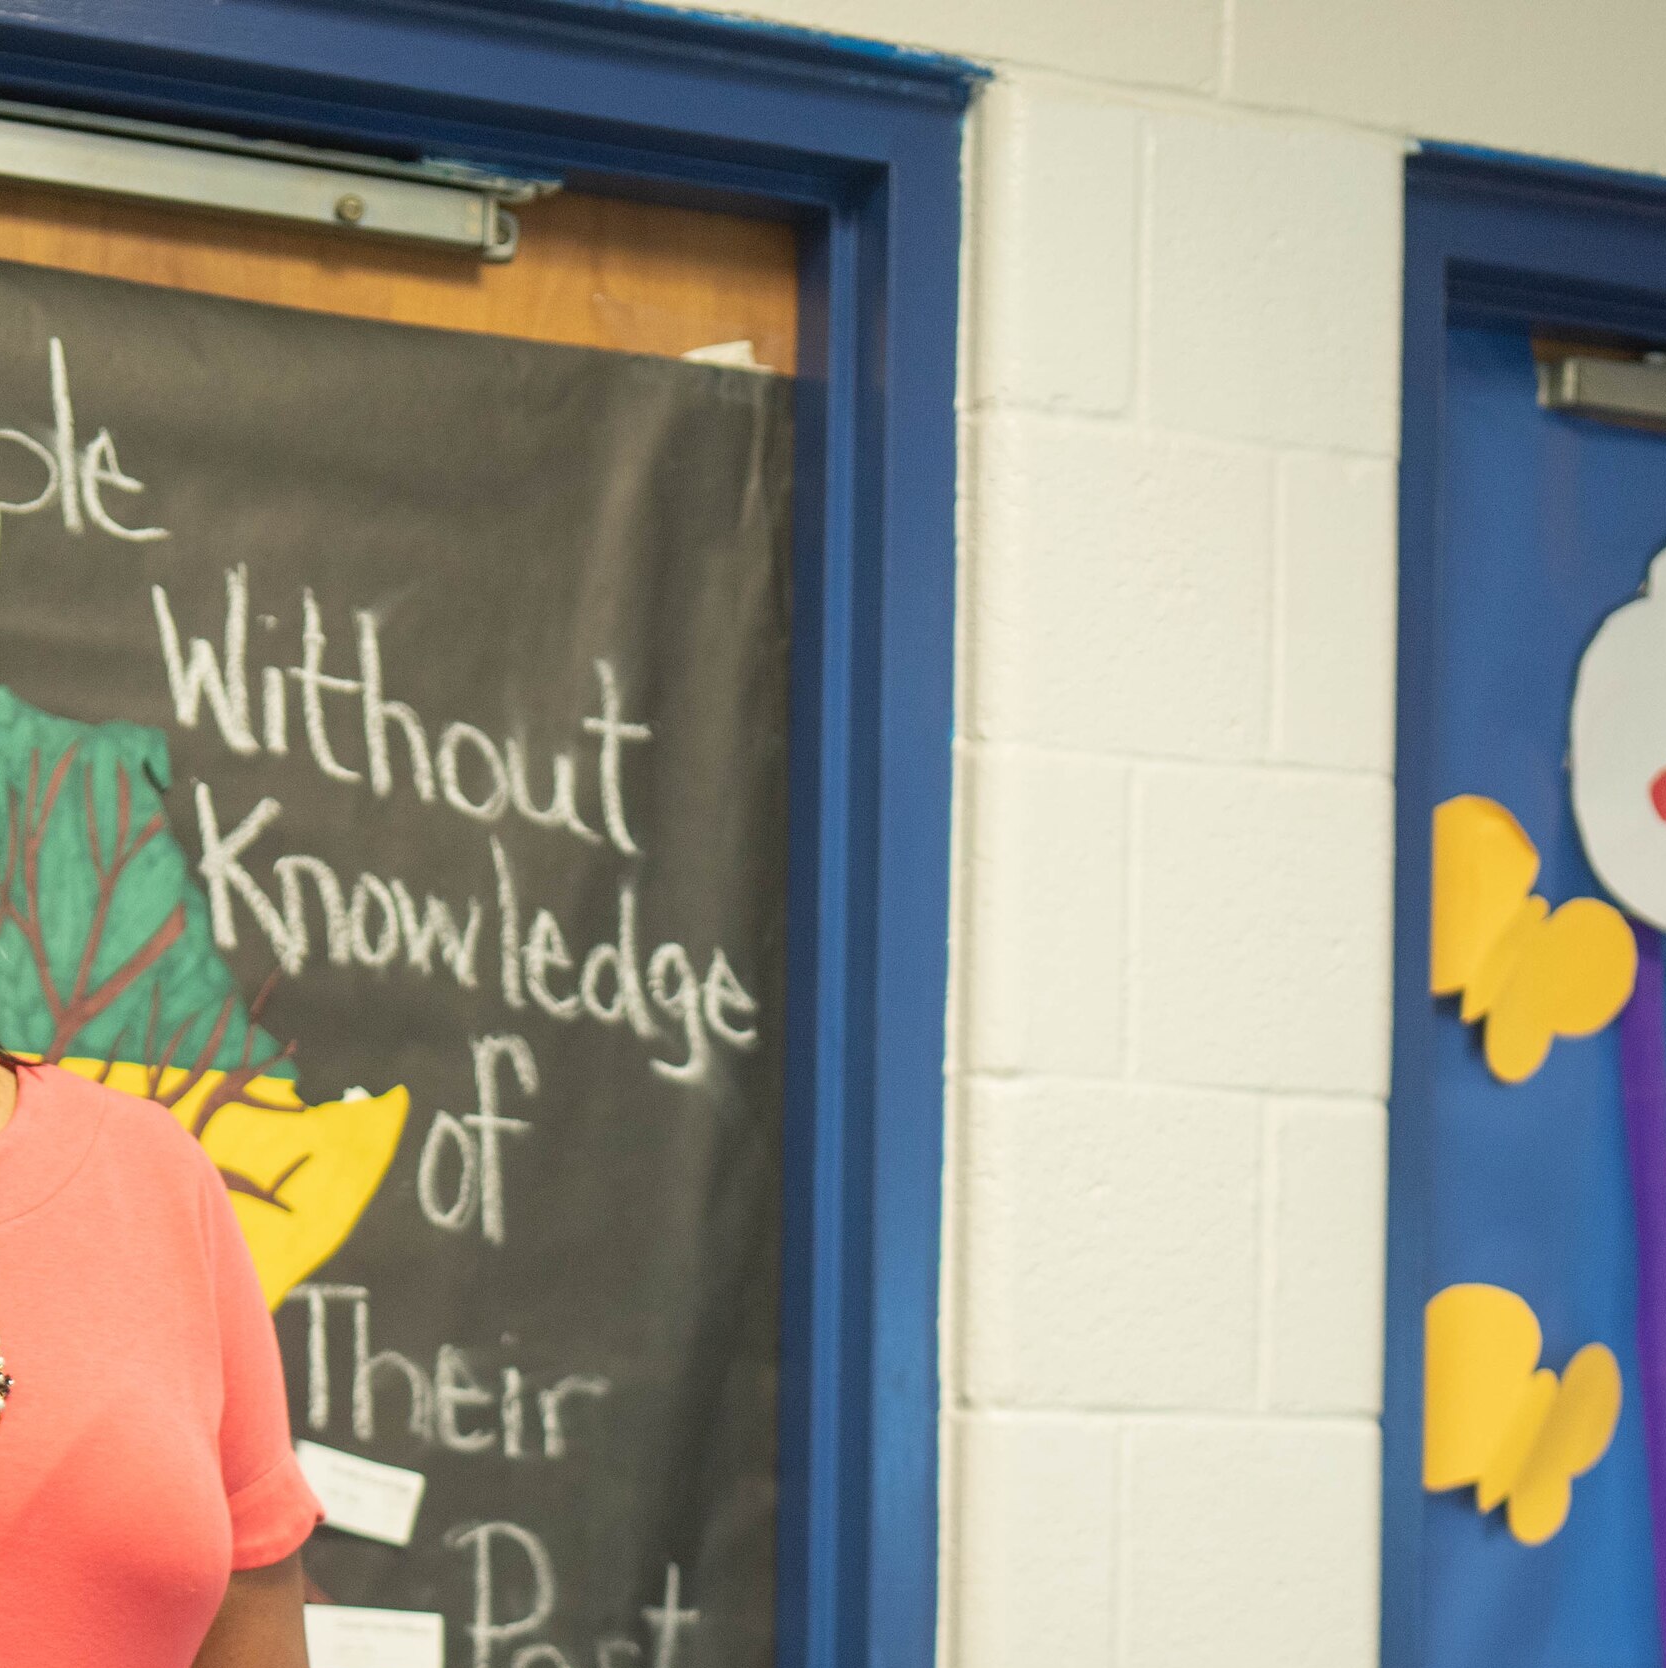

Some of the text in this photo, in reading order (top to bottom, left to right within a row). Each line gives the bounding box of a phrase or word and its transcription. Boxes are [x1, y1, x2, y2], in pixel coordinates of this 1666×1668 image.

[152, 561, 653, 856] Without
[193, 780, 758, 1081] Knowledge
[417, 1033, 540, 1246] of
[286, 1284, 609, 1457] Their
